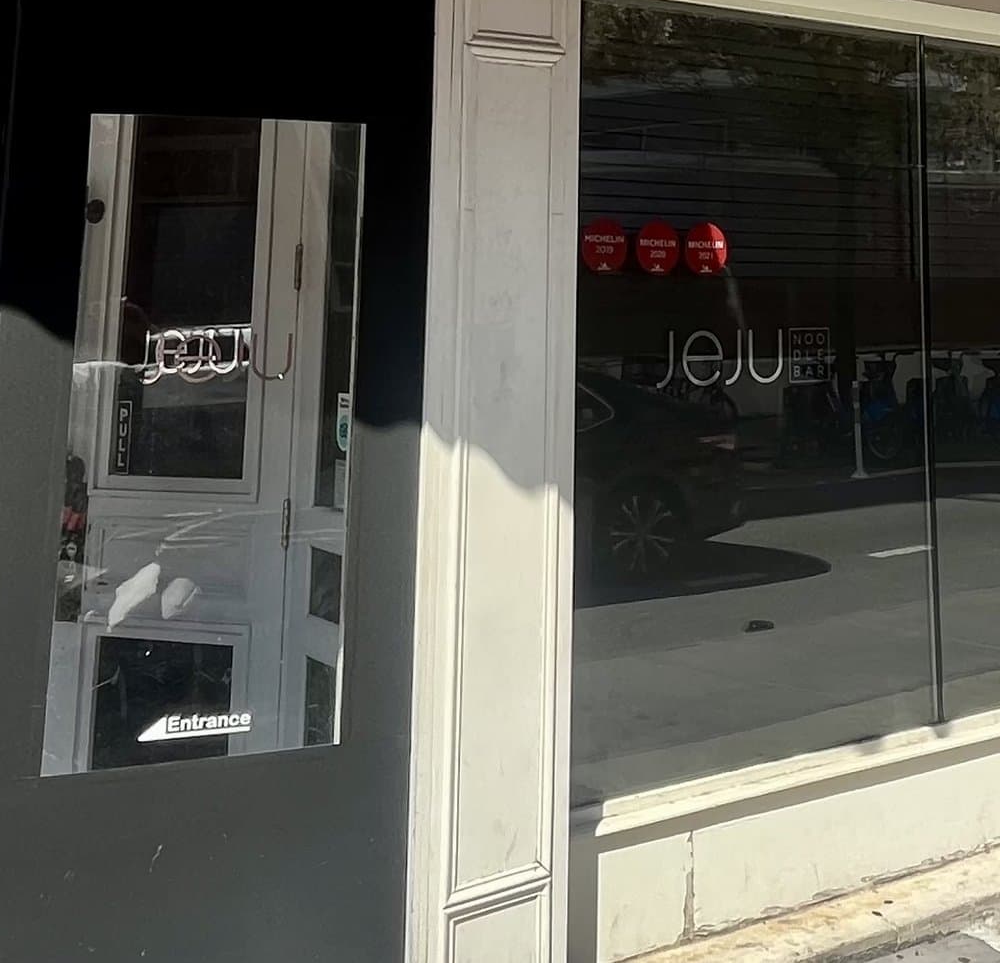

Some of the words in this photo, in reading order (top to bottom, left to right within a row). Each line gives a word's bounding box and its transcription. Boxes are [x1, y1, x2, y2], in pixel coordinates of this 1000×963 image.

[584, 235, 625, 243] MICHELIN
[639, 239, 676, 248] MICHELIN
[688, 241, 724, 249] MICHELIN
[792, 333, 825, 345] NOO
[793, 365, 825, 377] BAR
[117, 407, 129, 467] PULL
[168, 714, 252, 732] Entrance
